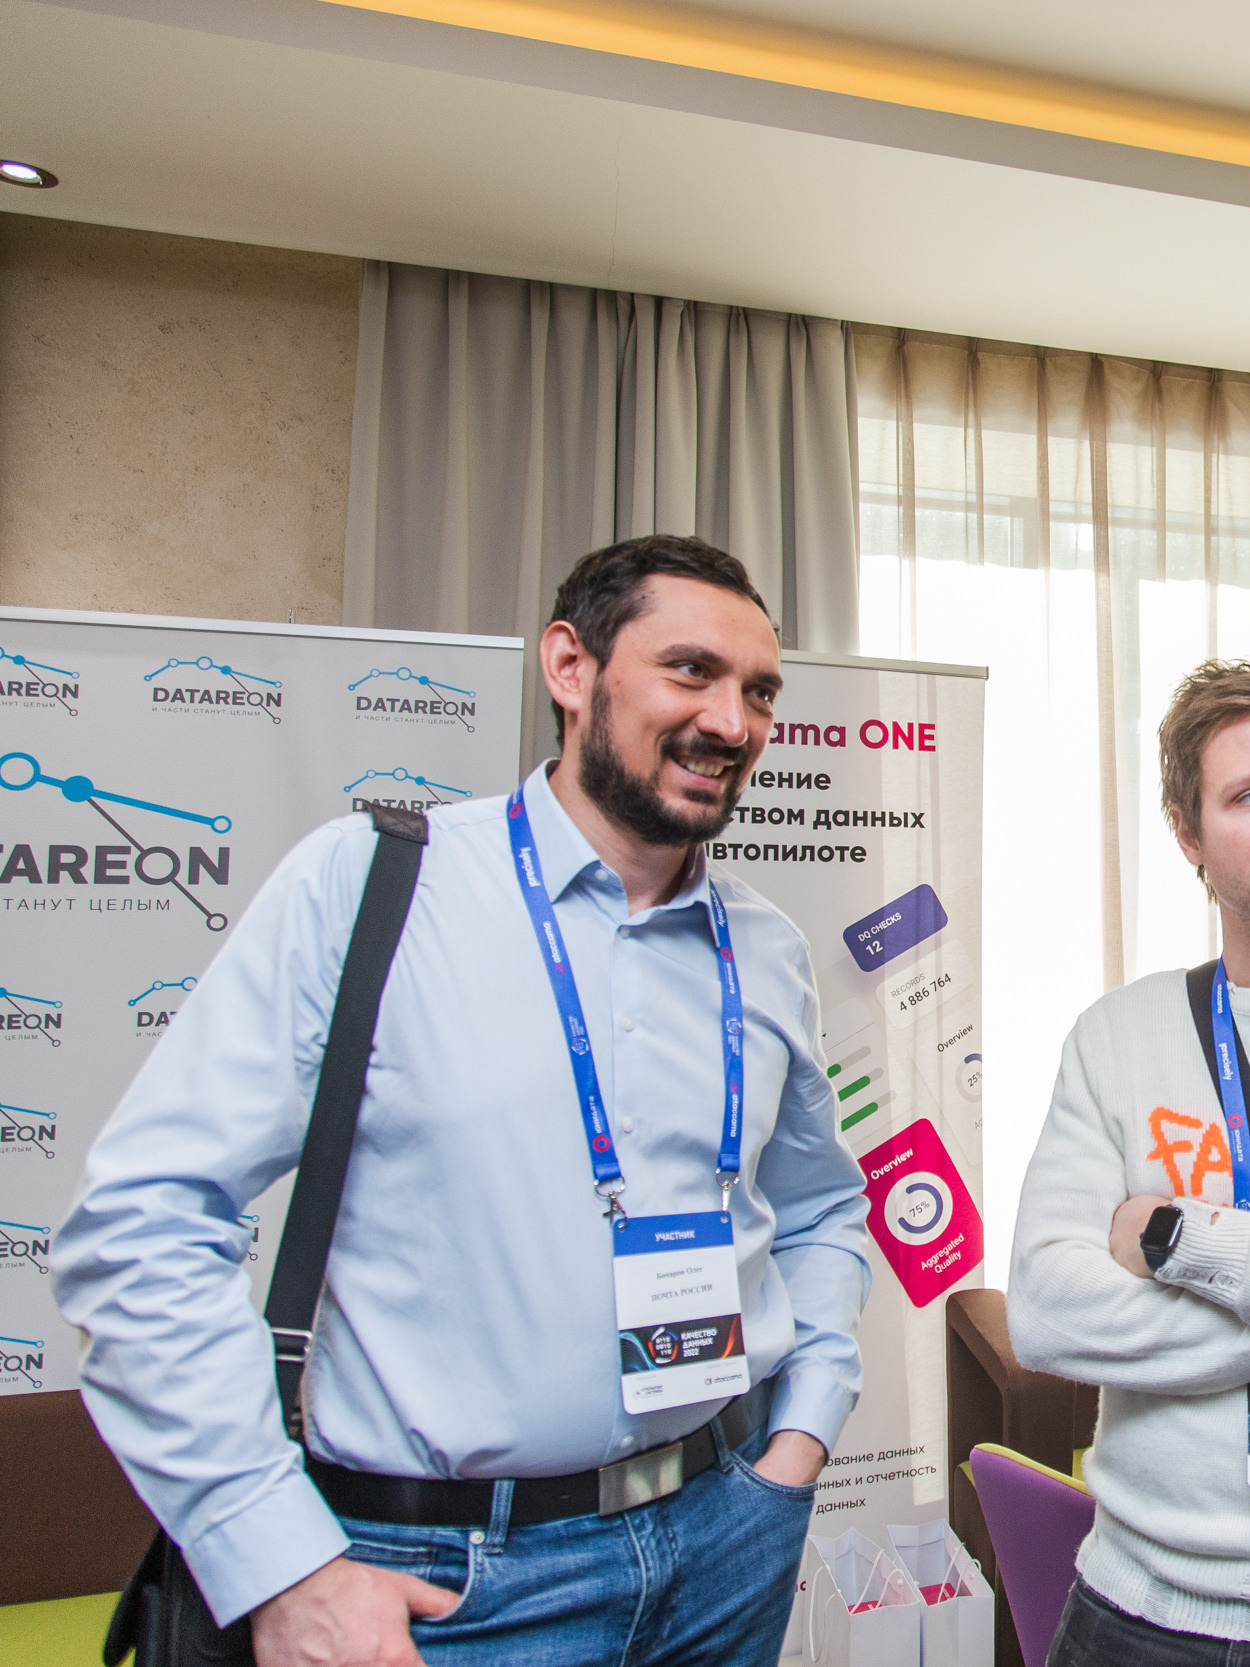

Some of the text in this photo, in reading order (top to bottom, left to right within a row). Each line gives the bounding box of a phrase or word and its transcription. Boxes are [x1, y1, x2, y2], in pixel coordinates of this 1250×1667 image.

[152, 687, 282, 707] DATAREON
[356, 696, 476, 716] DATAREON
[859, 719, 936, 752] ONE
[352, 798, 453, 814] DTARE
[727, 806, 926, 830] твом данных
[0, 844, 231, 885] AREON
[518, 846, 542, 888] precisely
[89, 898, 171, 913] ЦЕЛЫМ
[857, 912, 903, 942] DQ CHECKS
[865, 940, 884, 956] 12
[890, 973, 926, 998] RECORDS
[899, 973, 953, 1012] 4 886 764
[936, 1023, 974, 1053] Overview
[1218, 1042, 1234, 1081] precisely
[731, 1093, 739, 1138] ataccama
[870, 1147, 915, 1181] Overview
[909, 1200, 931, 1219] 75%
[655, 1229, 696, 1242] УЧАСТНИК
[920, 1232, 965, 1271] Aggregated
[934, 1250, 962, 1274] Quality
[651, 1284, 713, 1302] ПОЧТА РОССИИ
[681, 1327, 718, 1340] КАЧЕСТВО
[682, 1337, 713, 1349] ДАННЫХ
[683, 1348, 699, 1358] 2022
[877, 1445, 925, 1462] данных
[855, 1476, 863, 1486] и
[866, 1465, 937, 1484] отчетность
[815, 1498, 866, 1515] данных
